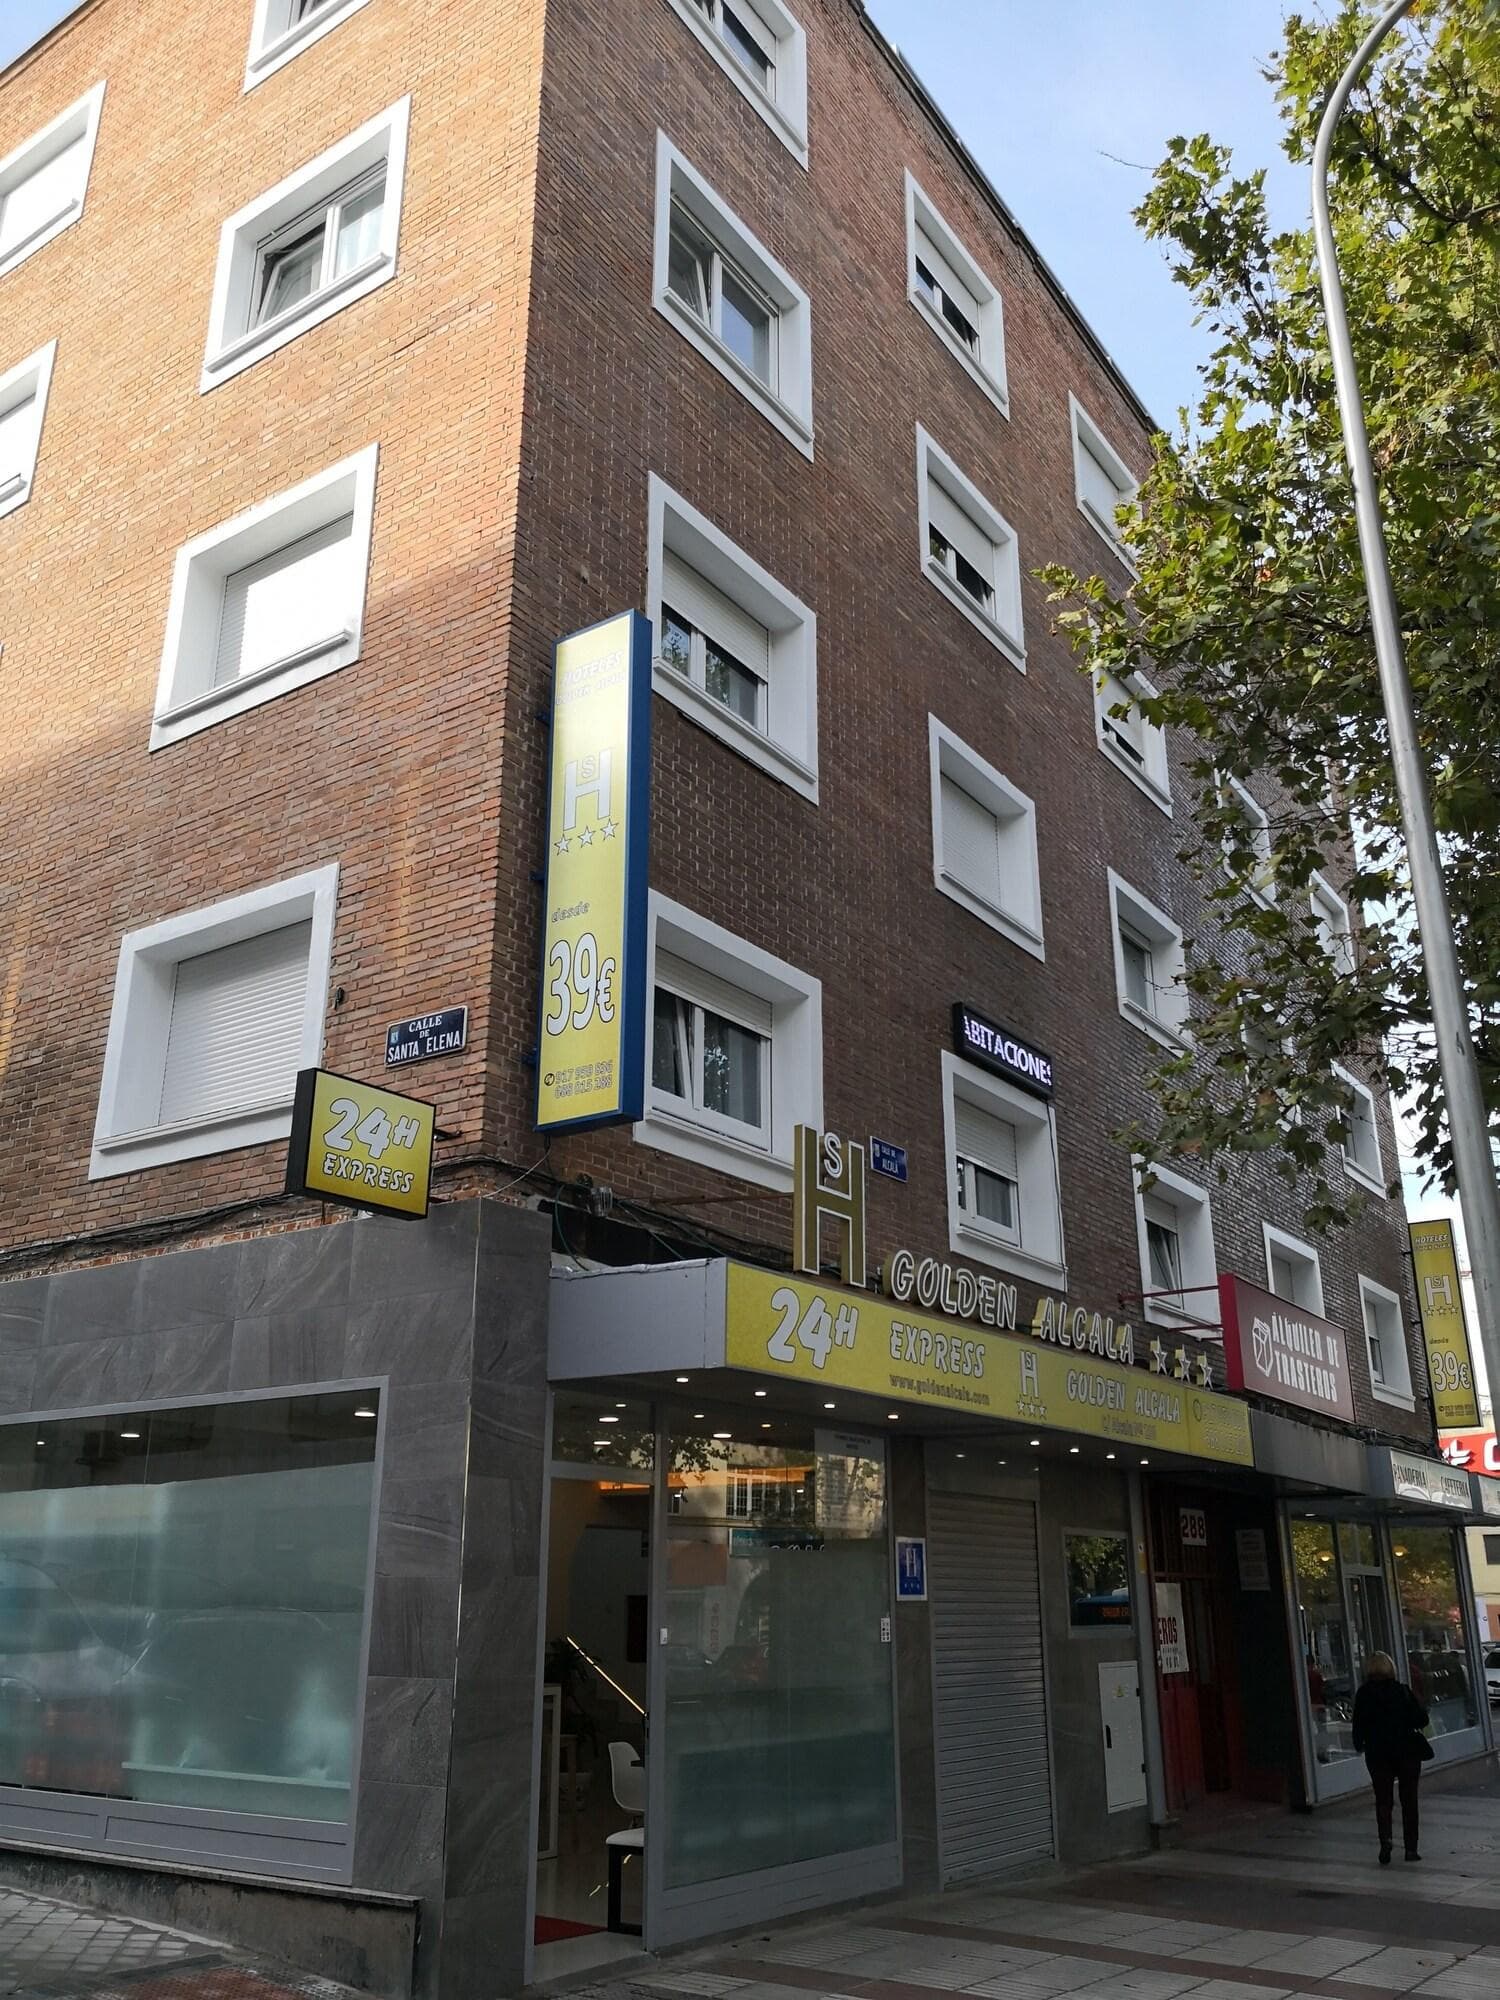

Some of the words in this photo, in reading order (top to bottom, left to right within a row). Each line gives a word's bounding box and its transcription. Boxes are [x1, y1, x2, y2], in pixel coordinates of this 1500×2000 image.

[546, 932, 616, 1036] 39€
[409, 1015, 442, 1032] CALLE
[420, 1029, 430, 1038] DE
[388, 1041, 419, 1063] SANTA
[426, 1031, 460, 1053] ELENA
[323, 1152, 415, 1193] EXPRESS
[1415, 1234, 1448, 1244] HOTELES
[889, 1250, 1018, 1331] GOLDEN
[1037, 1296, 1135, 1365] ALCALA
[889, 1320, 986, 1379] EXPRESS
[1271, 1312, 1323, 1361] ALQUILER
[1326, 1335, 1340, 1368] DE
[1274, 1350, 1338, 1402] TRASTEROS
[1431, 1350, 1472, 1392] 39€
[1067, 1368, 1126, 1411] GOLDEN
[1135, 1387, 1181, 1424] ALCALA
[1182, 1514, 1206, 1539] 288
